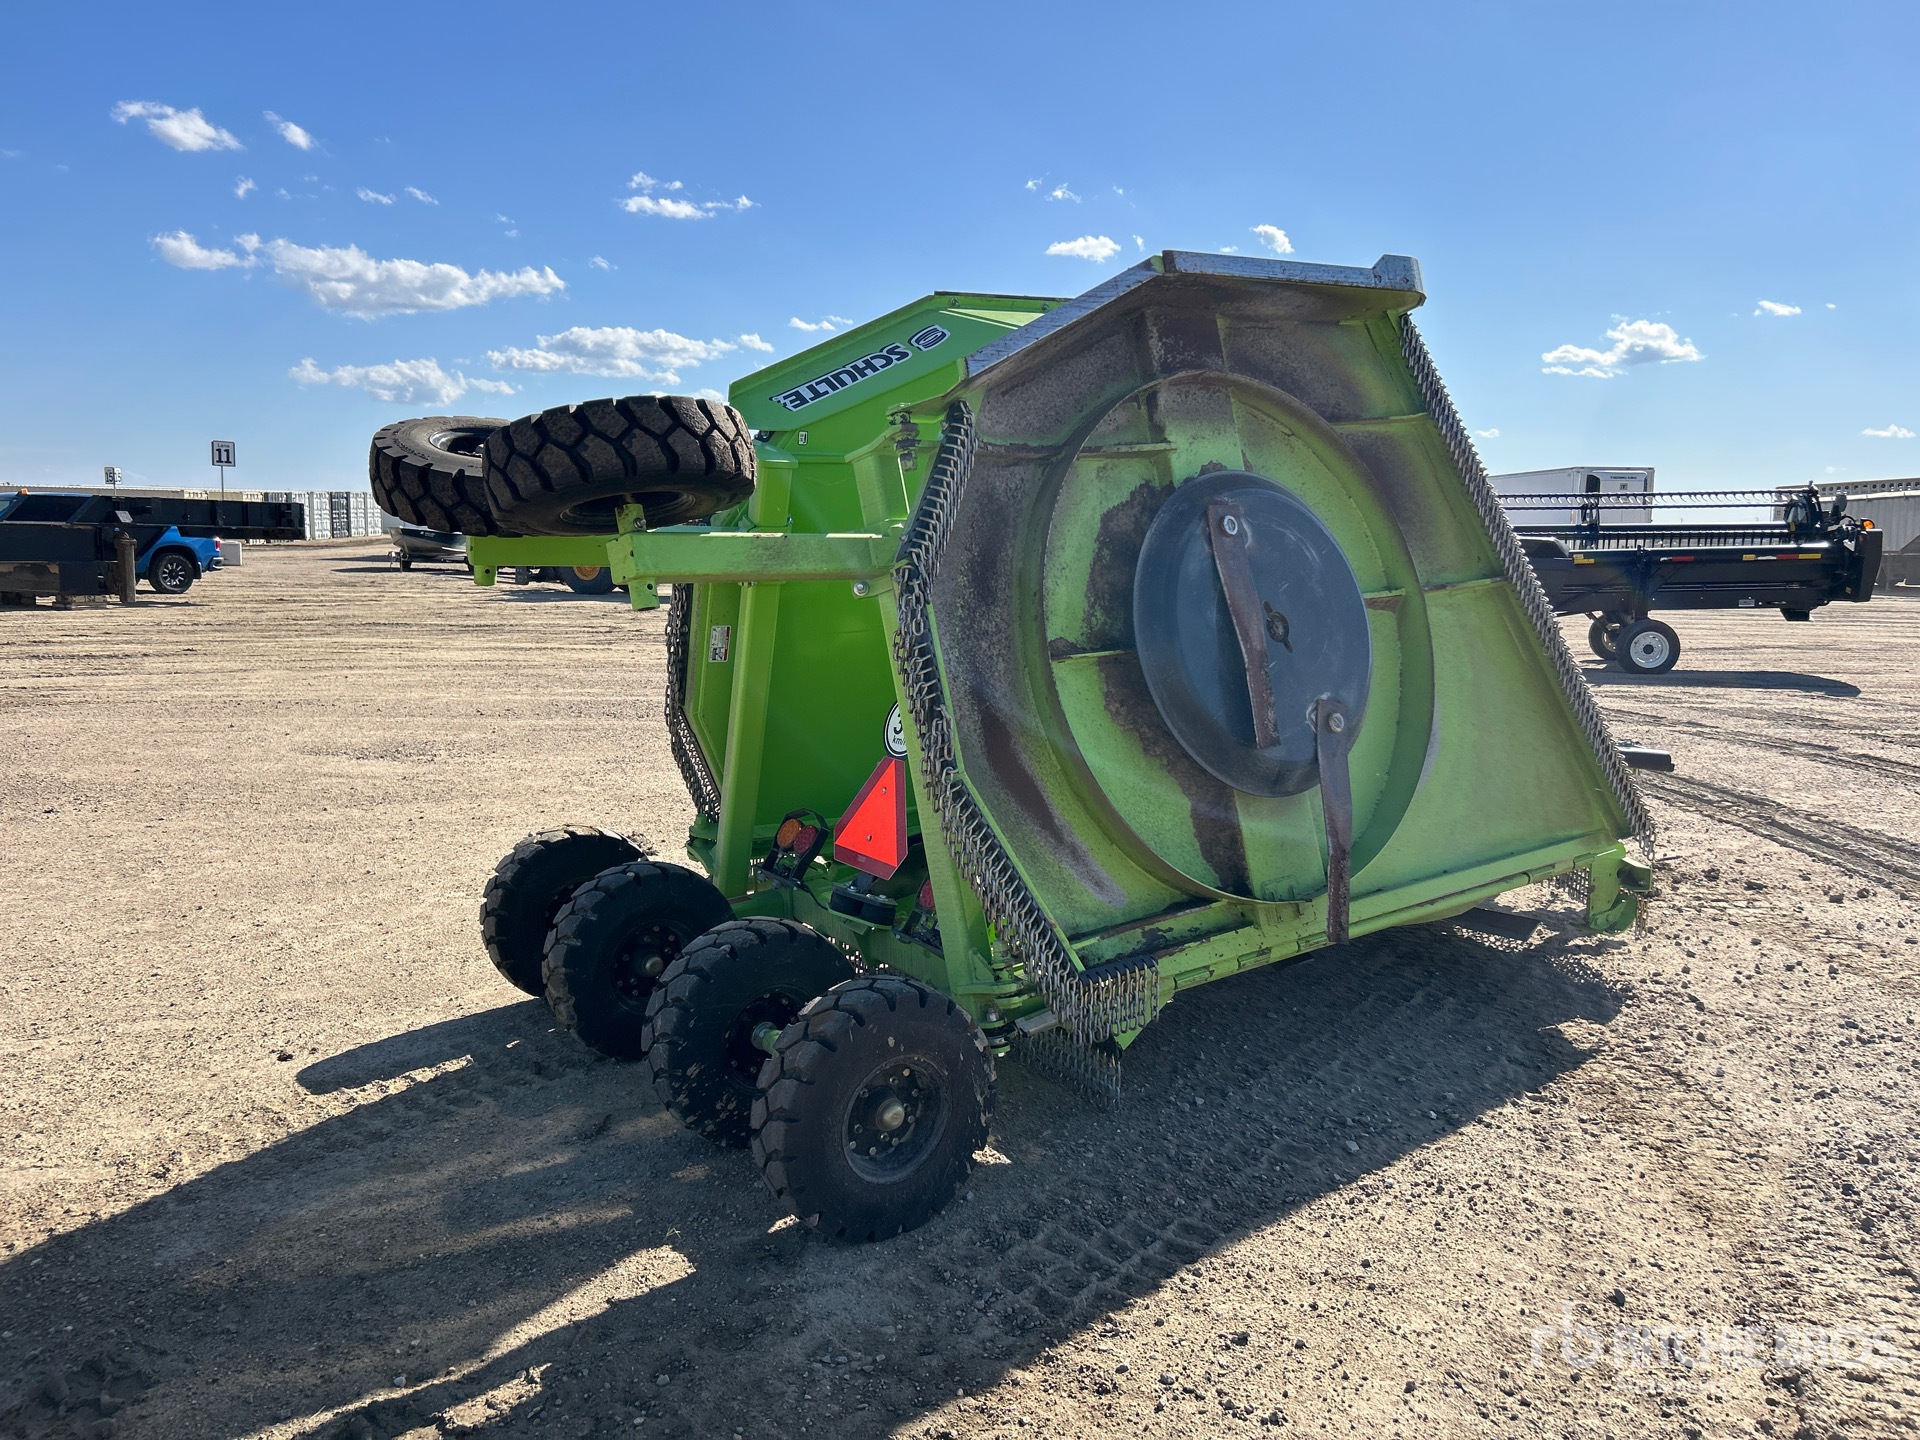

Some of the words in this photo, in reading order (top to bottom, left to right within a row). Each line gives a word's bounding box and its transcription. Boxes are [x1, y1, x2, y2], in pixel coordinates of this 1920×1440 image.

[781, 344, 910, 410] SCHULTE
[216, 448, 232, 464] 11
[105, 472, 113, 483] 15
